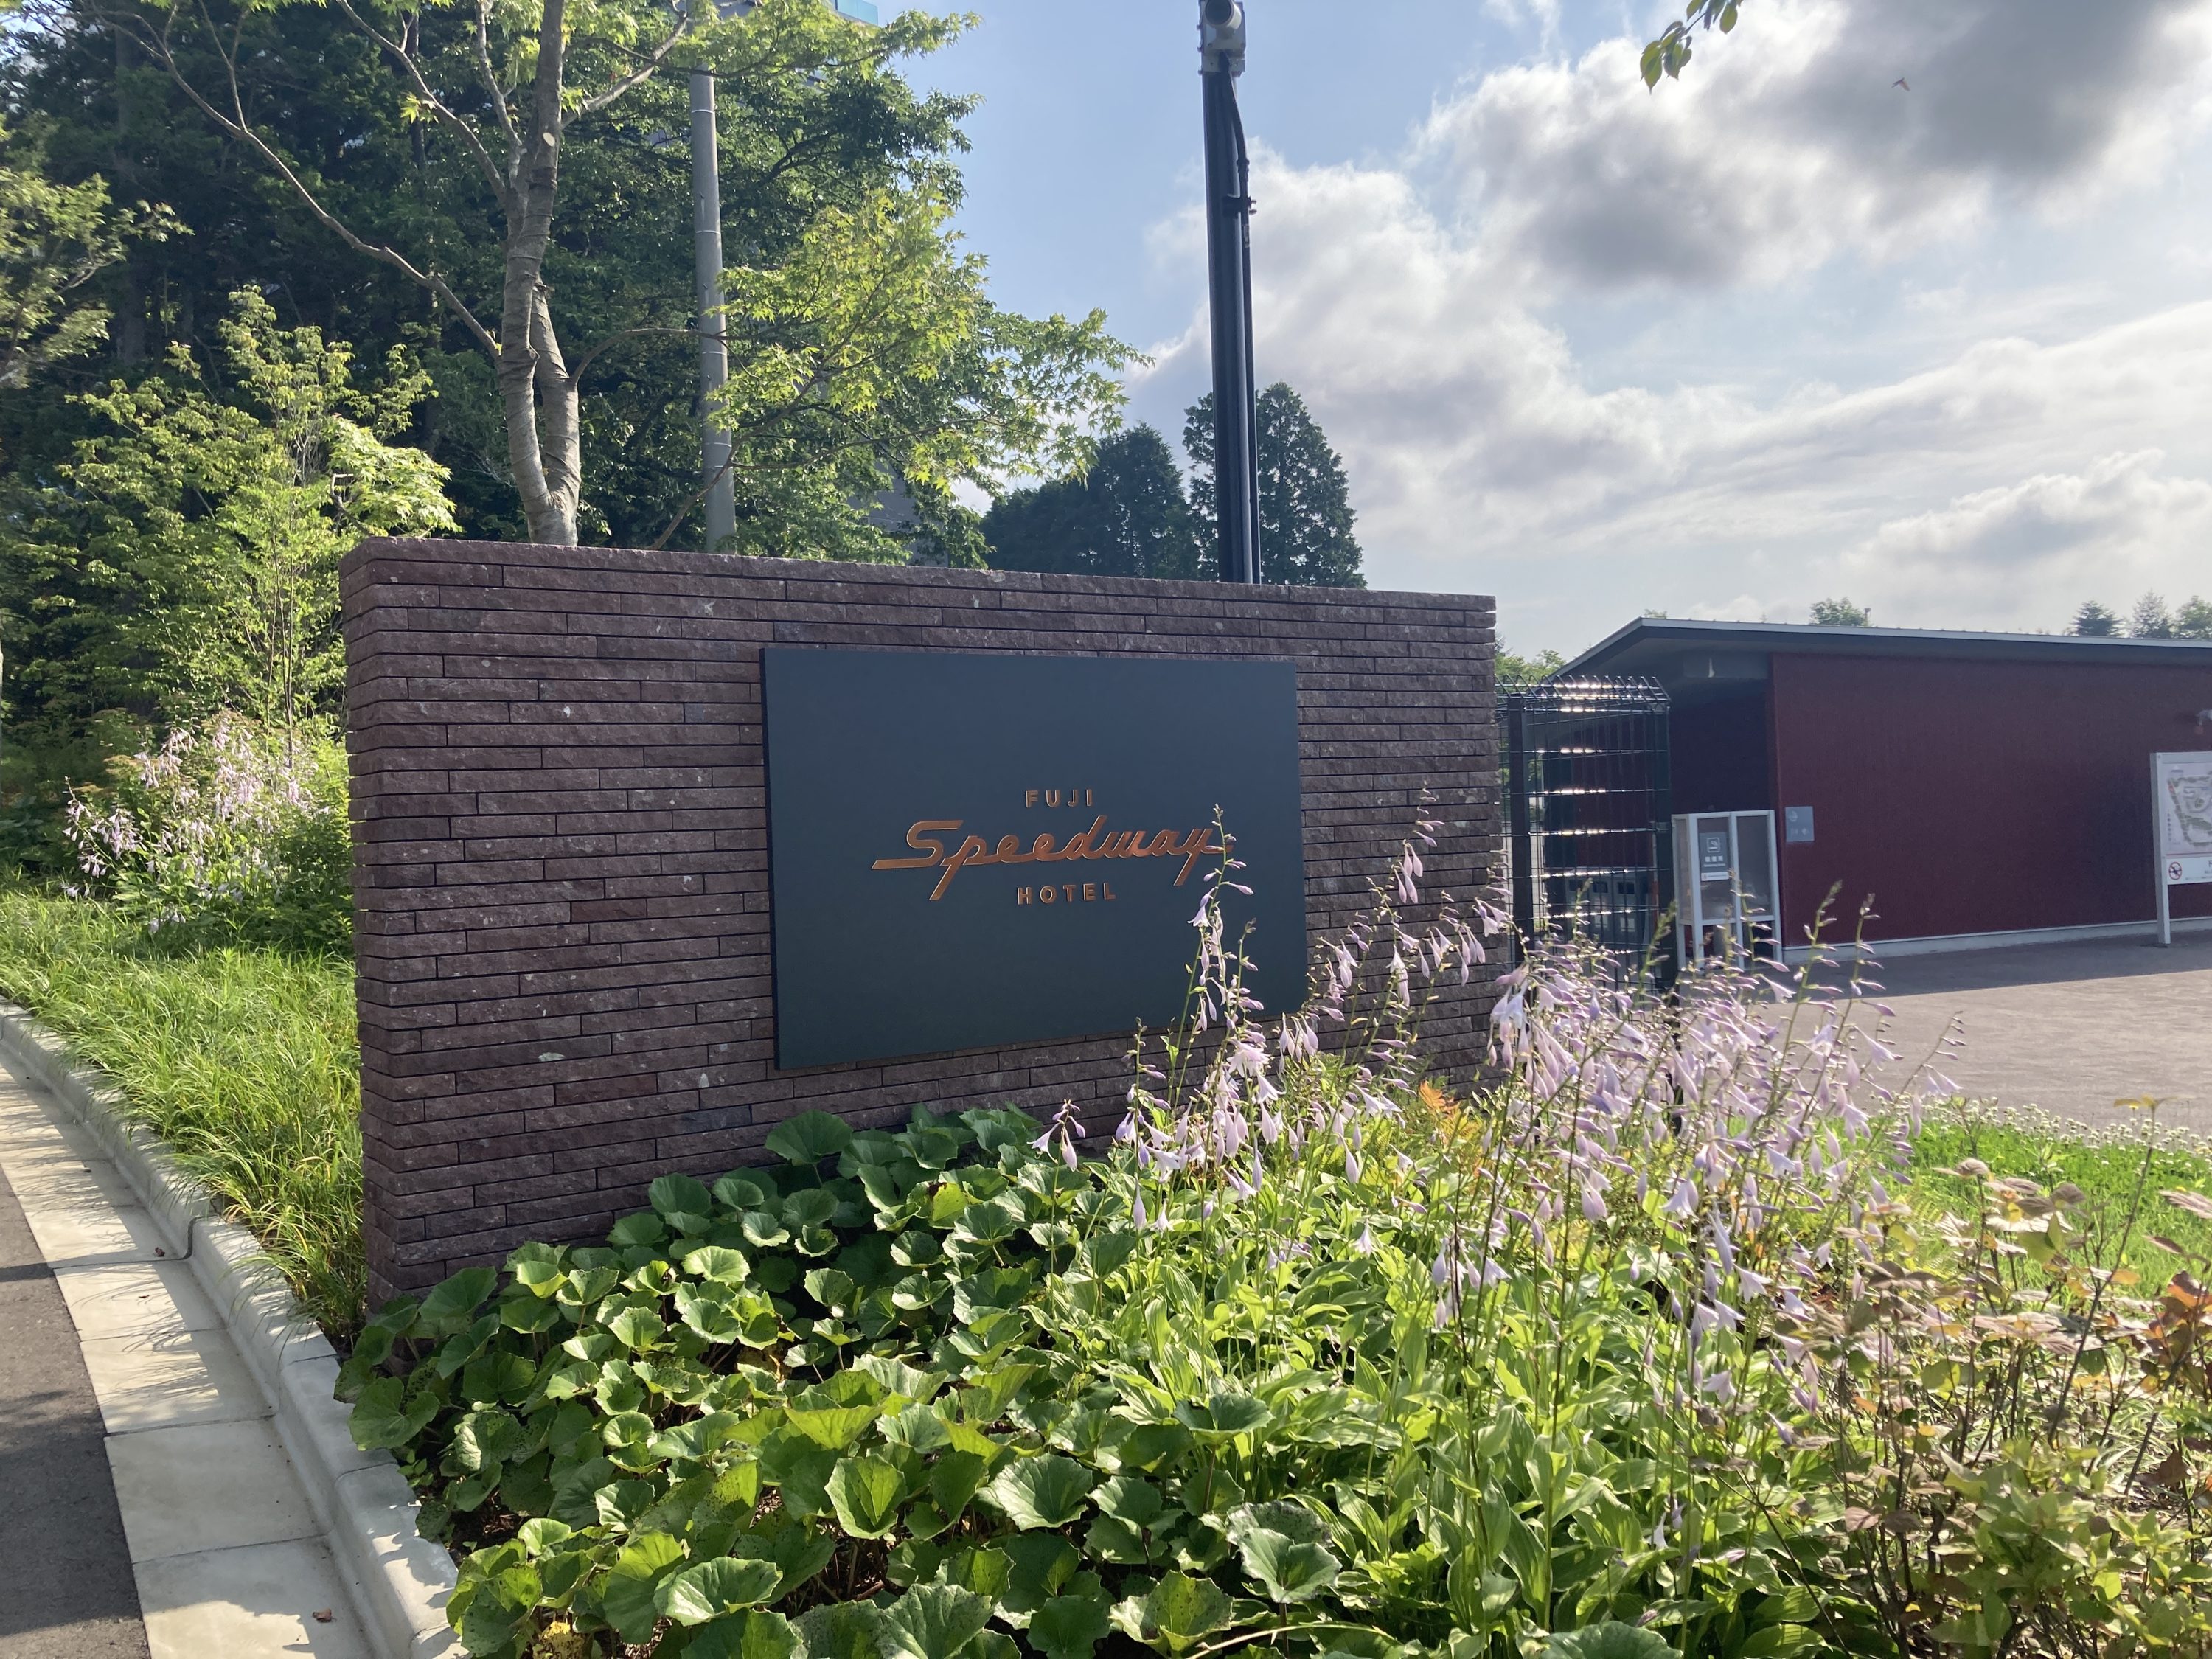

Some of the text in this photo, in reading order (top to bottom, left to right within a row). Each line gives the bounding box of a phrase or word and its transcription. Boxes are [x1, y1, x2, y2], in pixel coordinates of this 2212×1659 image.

[1025, 789, 1093, 808] FUJI
[871, 815, 1234, 900] Speedway
[1017, 883, 1116, 905] HOTEL
